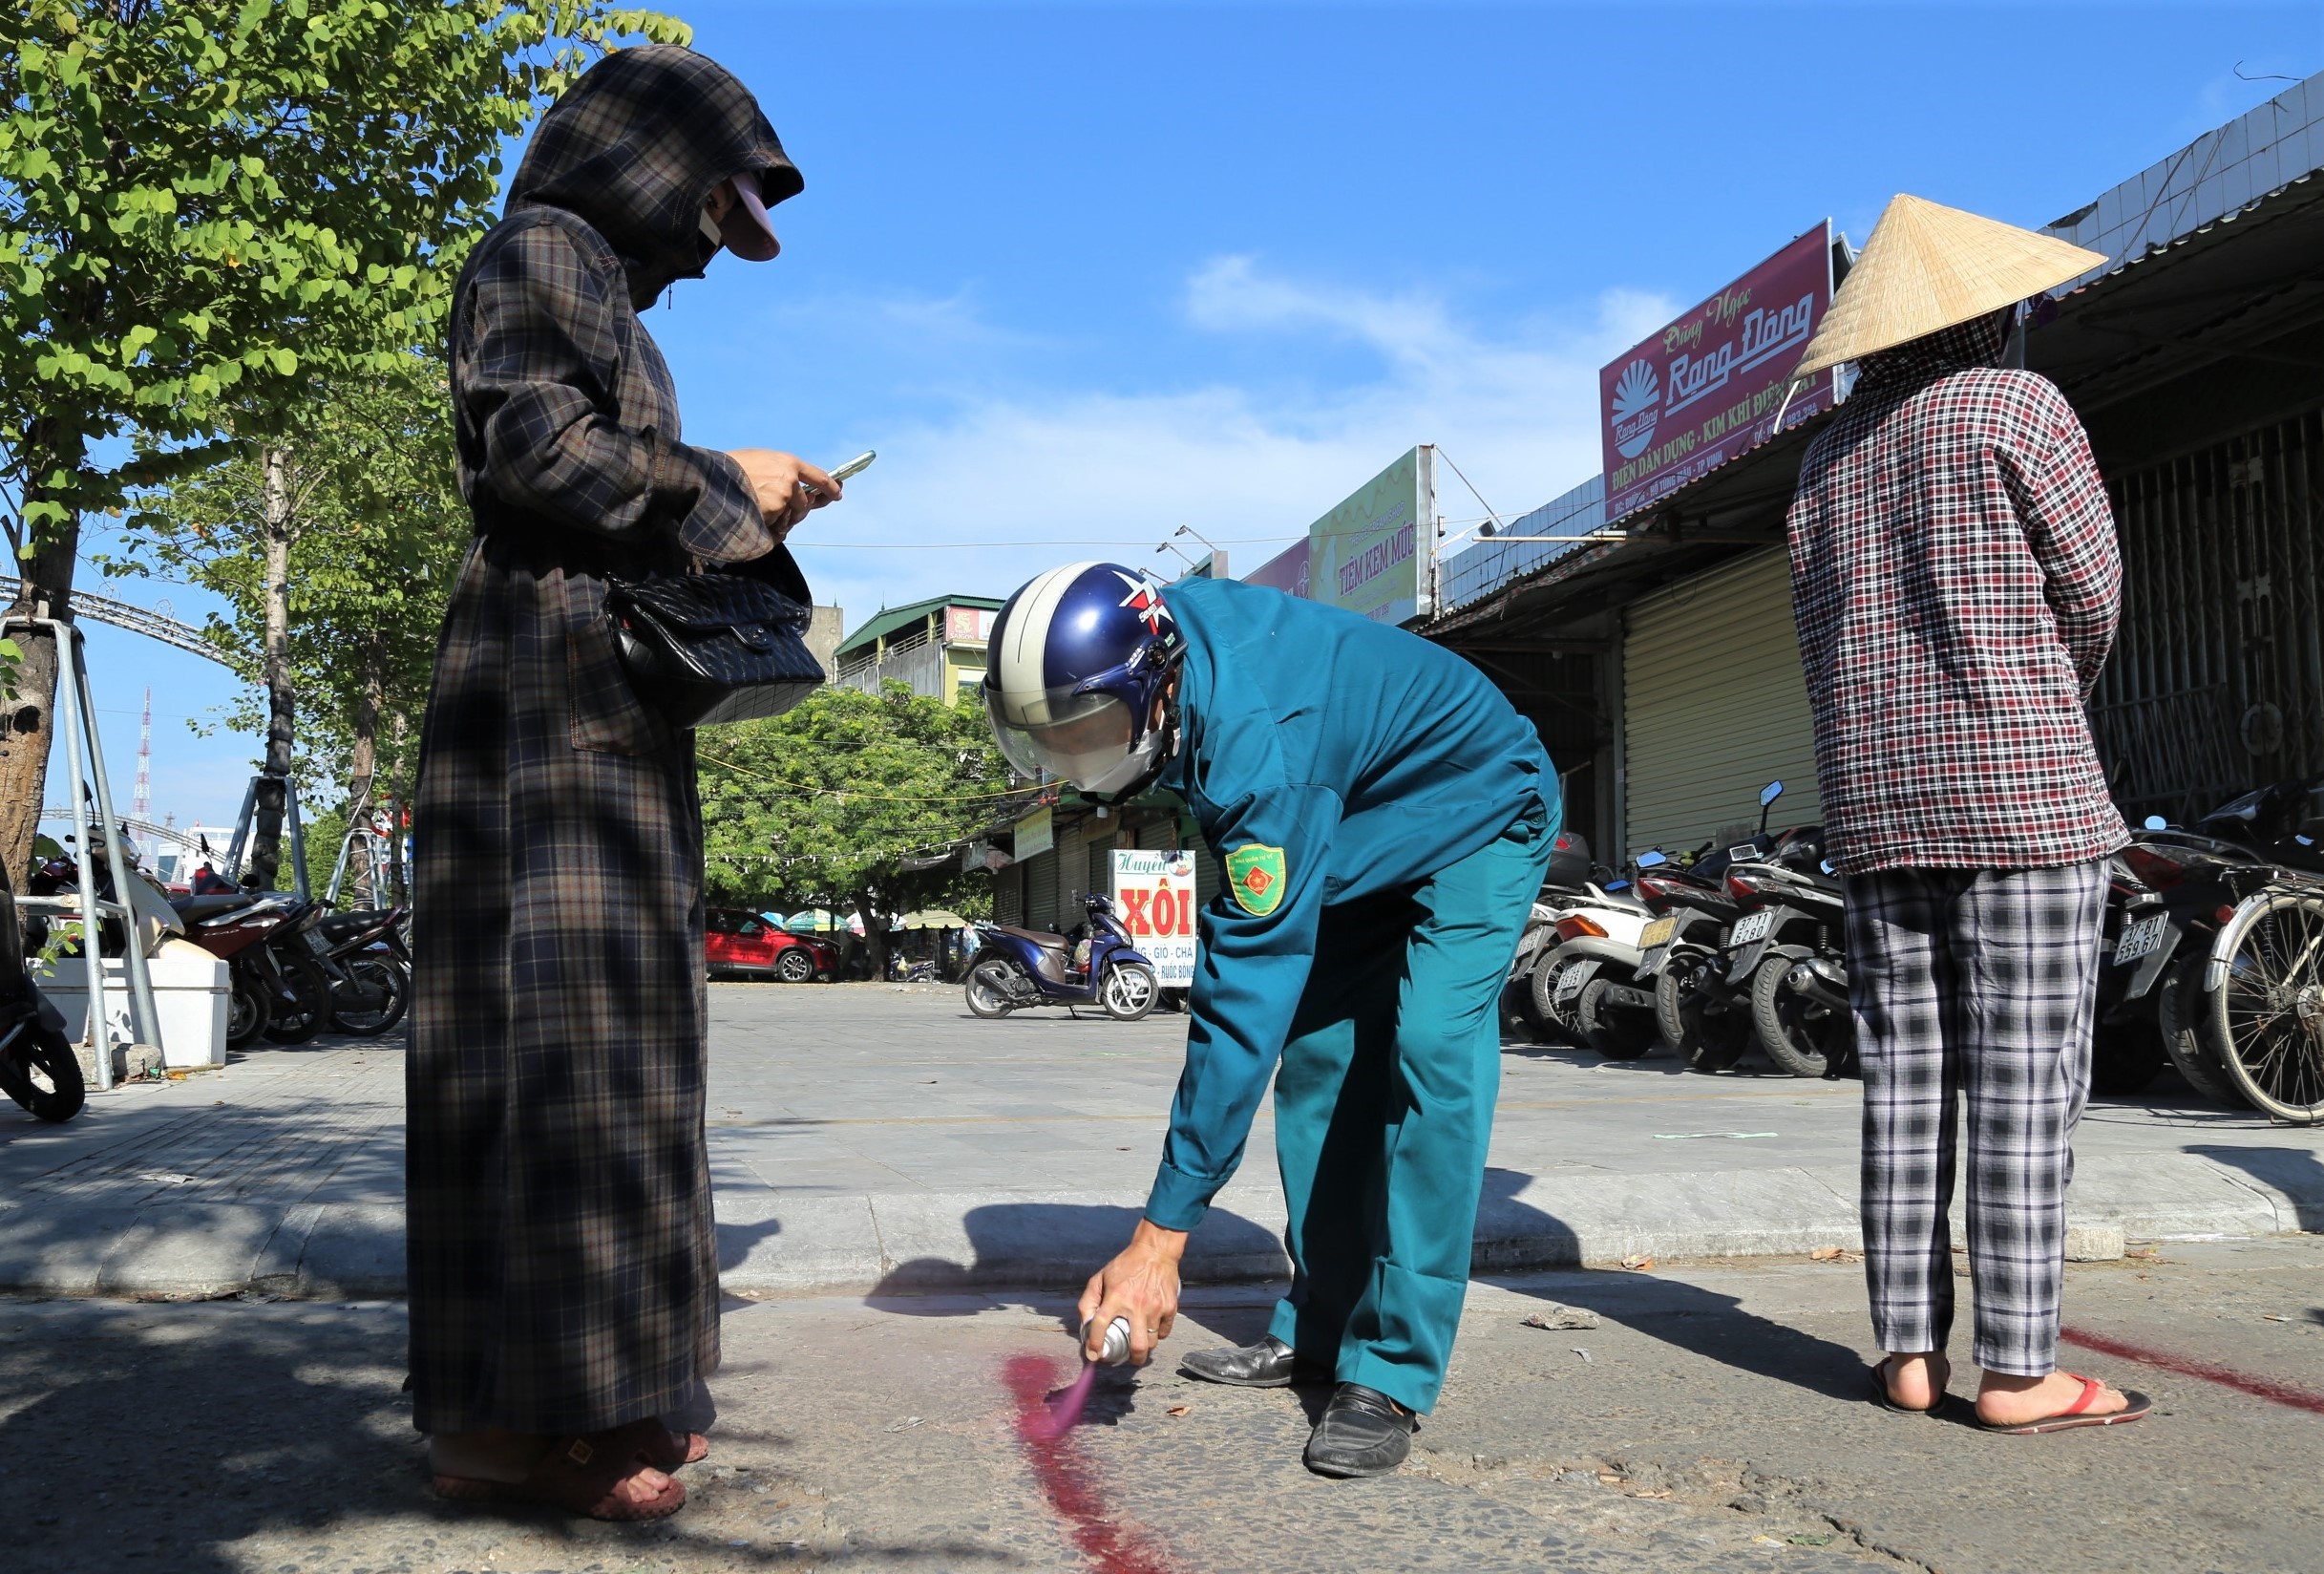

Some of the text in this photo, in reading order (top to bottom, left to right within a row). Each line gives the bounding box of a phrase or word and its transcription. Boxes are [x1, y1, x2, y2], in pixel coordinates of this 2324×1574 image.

[1705, 287, 1751, 329] Ngọc
[1665, 292, 1814, 408] Rạng Đông
[1612, 459, 1637, 492] ĐIỆN
[1637, 447, 1661, 478] DÂN
[1663, 431, 1696, 464] DỤNG
[1702, 415, 1726, 444] KIM
[1727, 393, 1751, 430] KHÍ
[1697, 459, 1705, 474] TP
[1706, 451, 1723, 468] VINH
[1339, 555, 1363, 597] TIỆM
[1364, 539, 1389, 581] KEM
[1116, 852, 1168, 873] Huyền
[1120, 878, 1193, 937] XÔI
[1739, 913, 1768, 931] 37-Y1
[1735, 925, 1764, 944] 6280
[2117, 932, 2159, 962] 559.67
[1153, 944, 1169, 959] GIÒ
